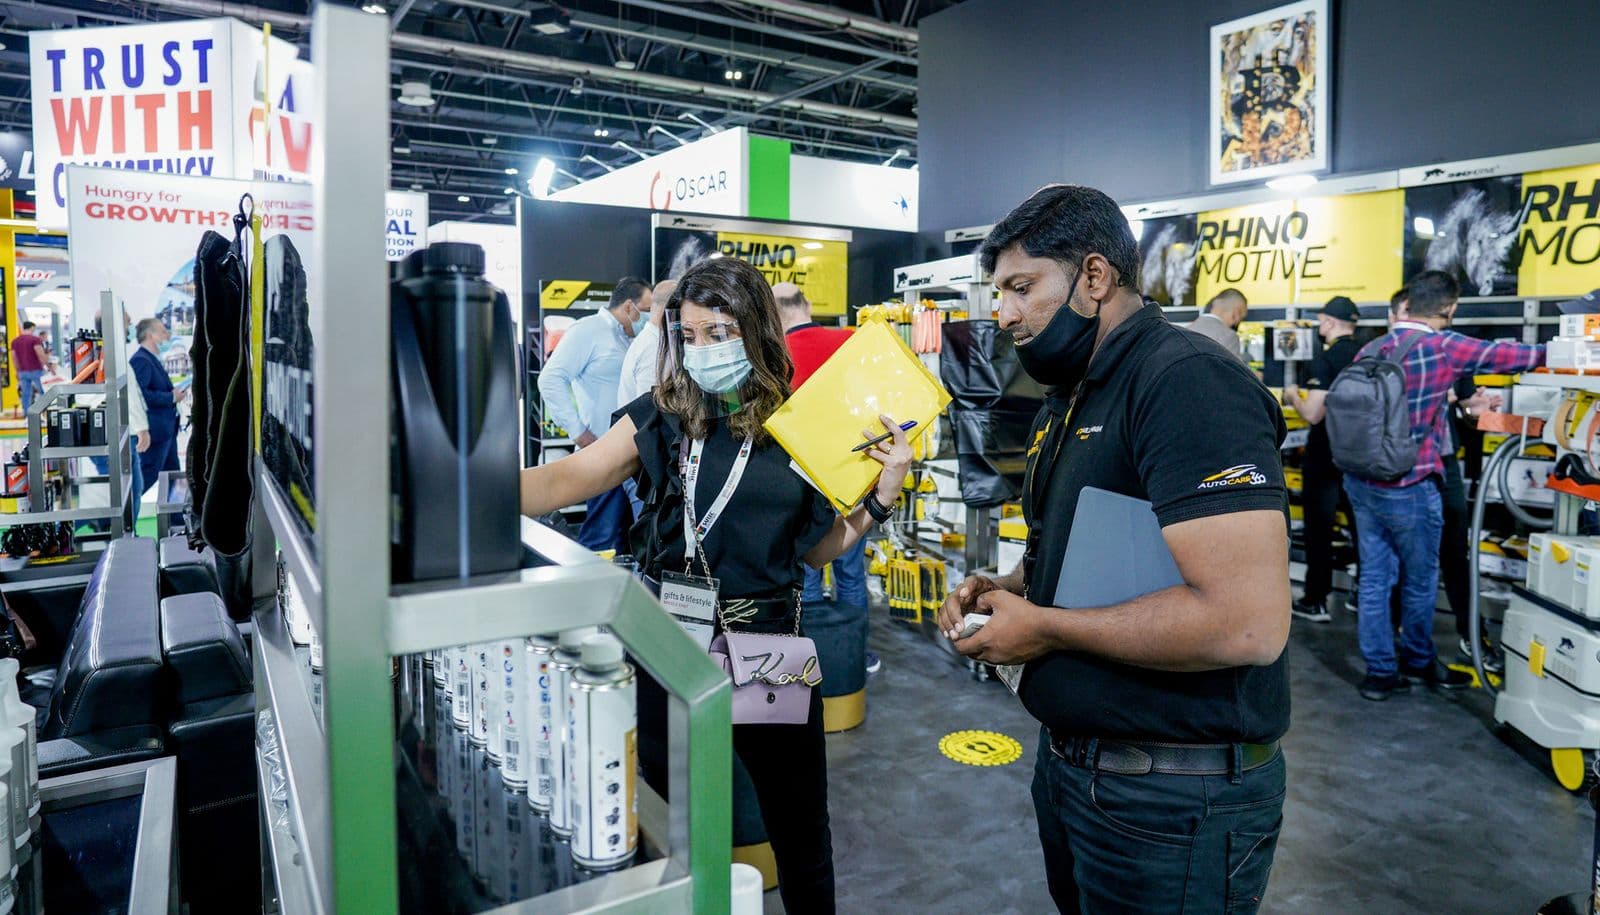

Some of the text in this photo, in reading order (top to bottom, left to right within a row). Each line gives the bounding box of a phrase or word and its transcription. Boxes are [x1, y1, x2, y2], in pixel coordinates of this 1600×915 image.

[46, 38, 213, 92] TRUST
[50, 89, 213, 156] WITH
[84, 184, 182, 204] Hungry for
[675, 170, 727, 201] OSCAR
[84, 202, 230, 227] GROWTH?
[385, 207, 413, 217] OUR
[386, 219, 417, 236] AL
[1200, 210, 1309, 250] RHINO
[386, 238, 414, 246] TION
[1196, 245, 1327, 284] MOTIVE
[759, 269, 807, 287] TIVE
[663, 592, 679, 601] gifts
[685, 595, 712, 608] lifestyle
